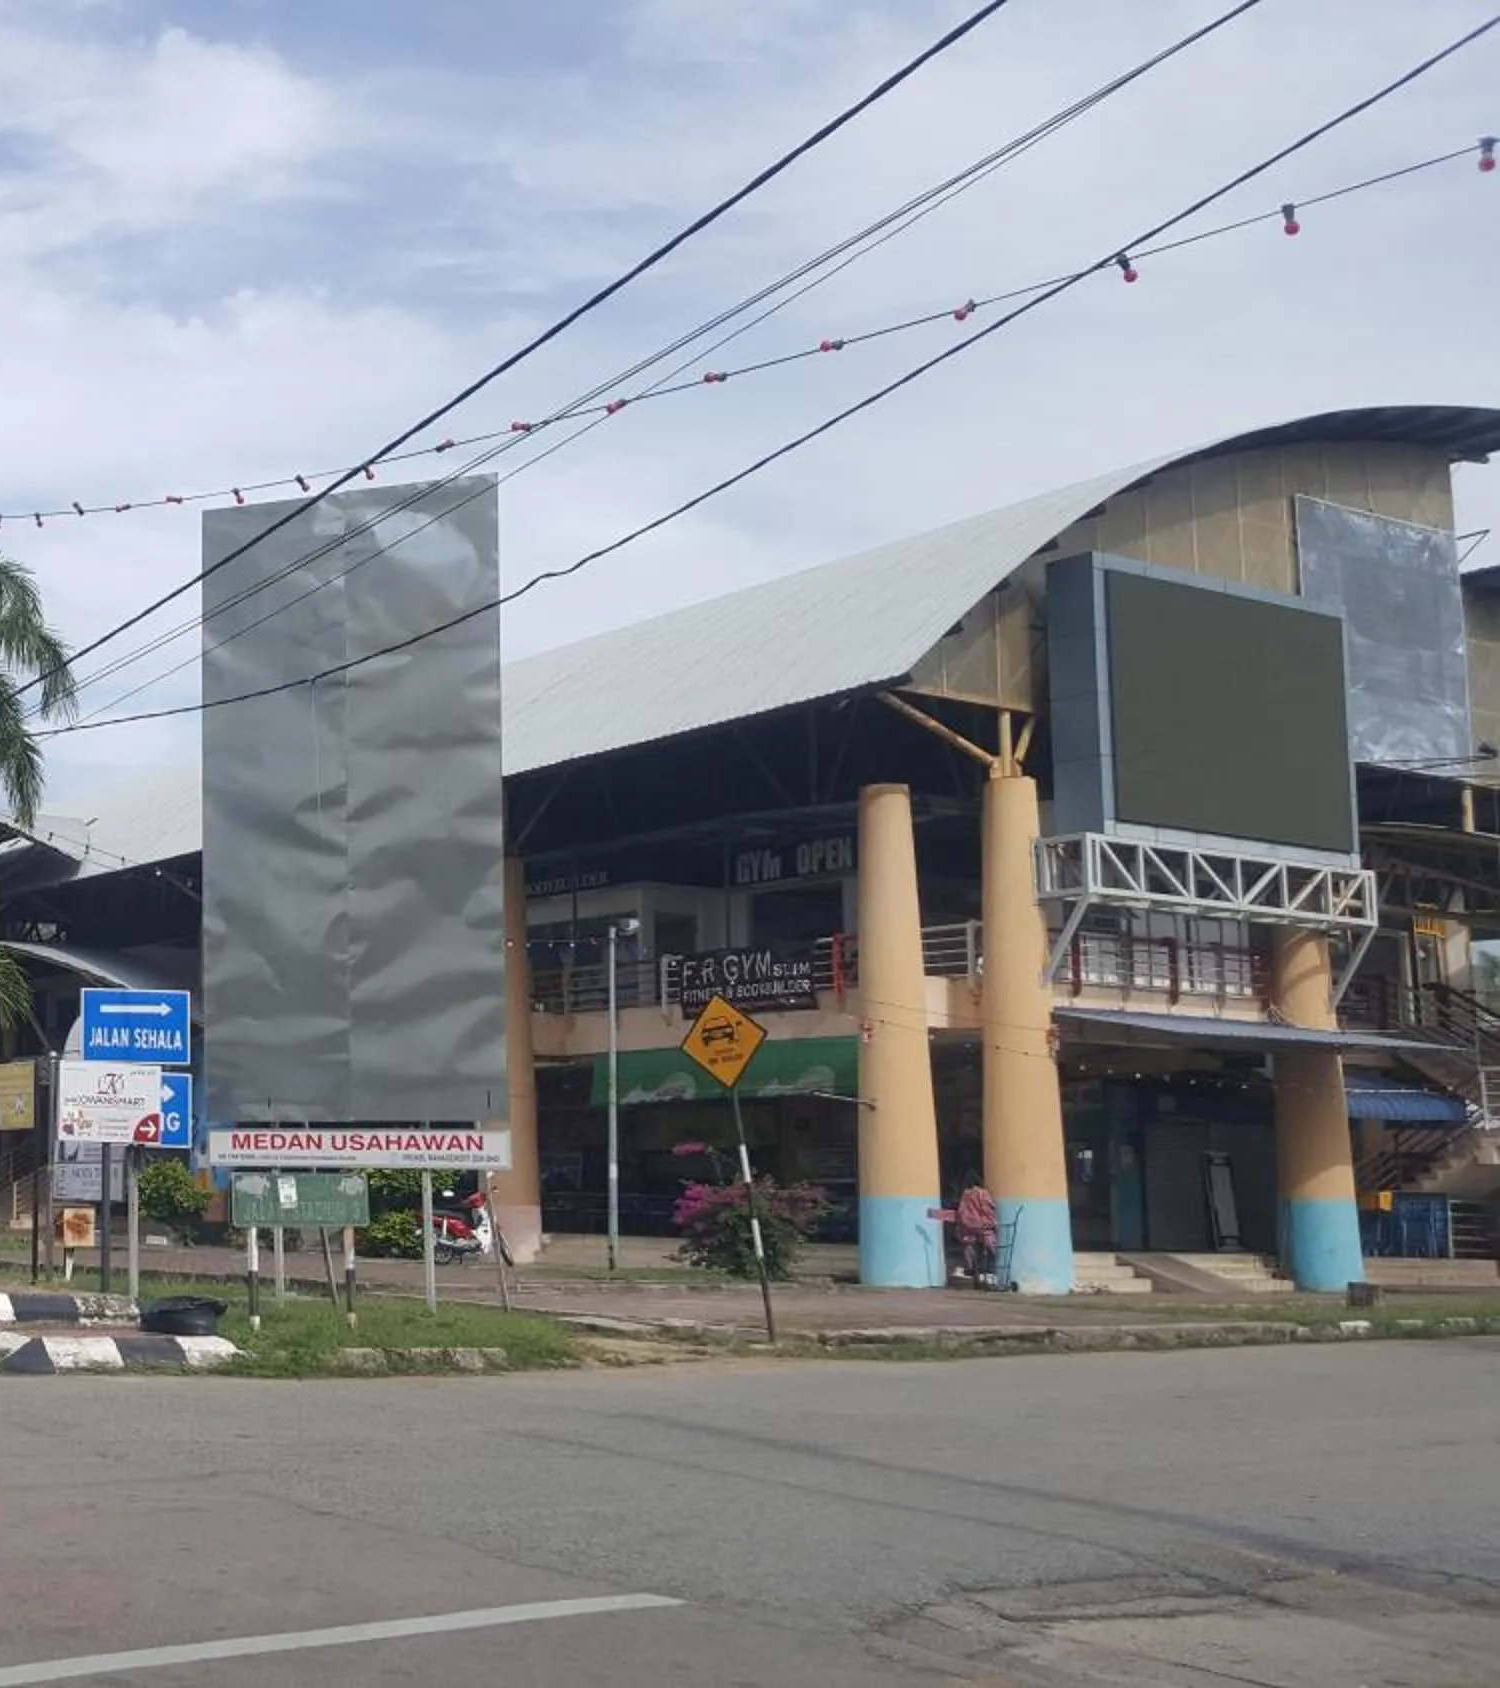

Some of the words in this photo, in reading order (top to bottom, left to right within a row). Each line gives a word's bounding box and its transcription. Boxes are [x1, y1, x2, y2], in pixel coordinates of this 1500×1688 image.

[796, 835, 853, 875] OPEN
[723, 949, 772, 984] GYM
[88, 1026, 130, 1048] JALAN
[133, 1027, 183, 1050] SEHALA
[231, 1132, 323, 1150] MEDAN
[331, 1133, 485, 1151] USAHAWAN
